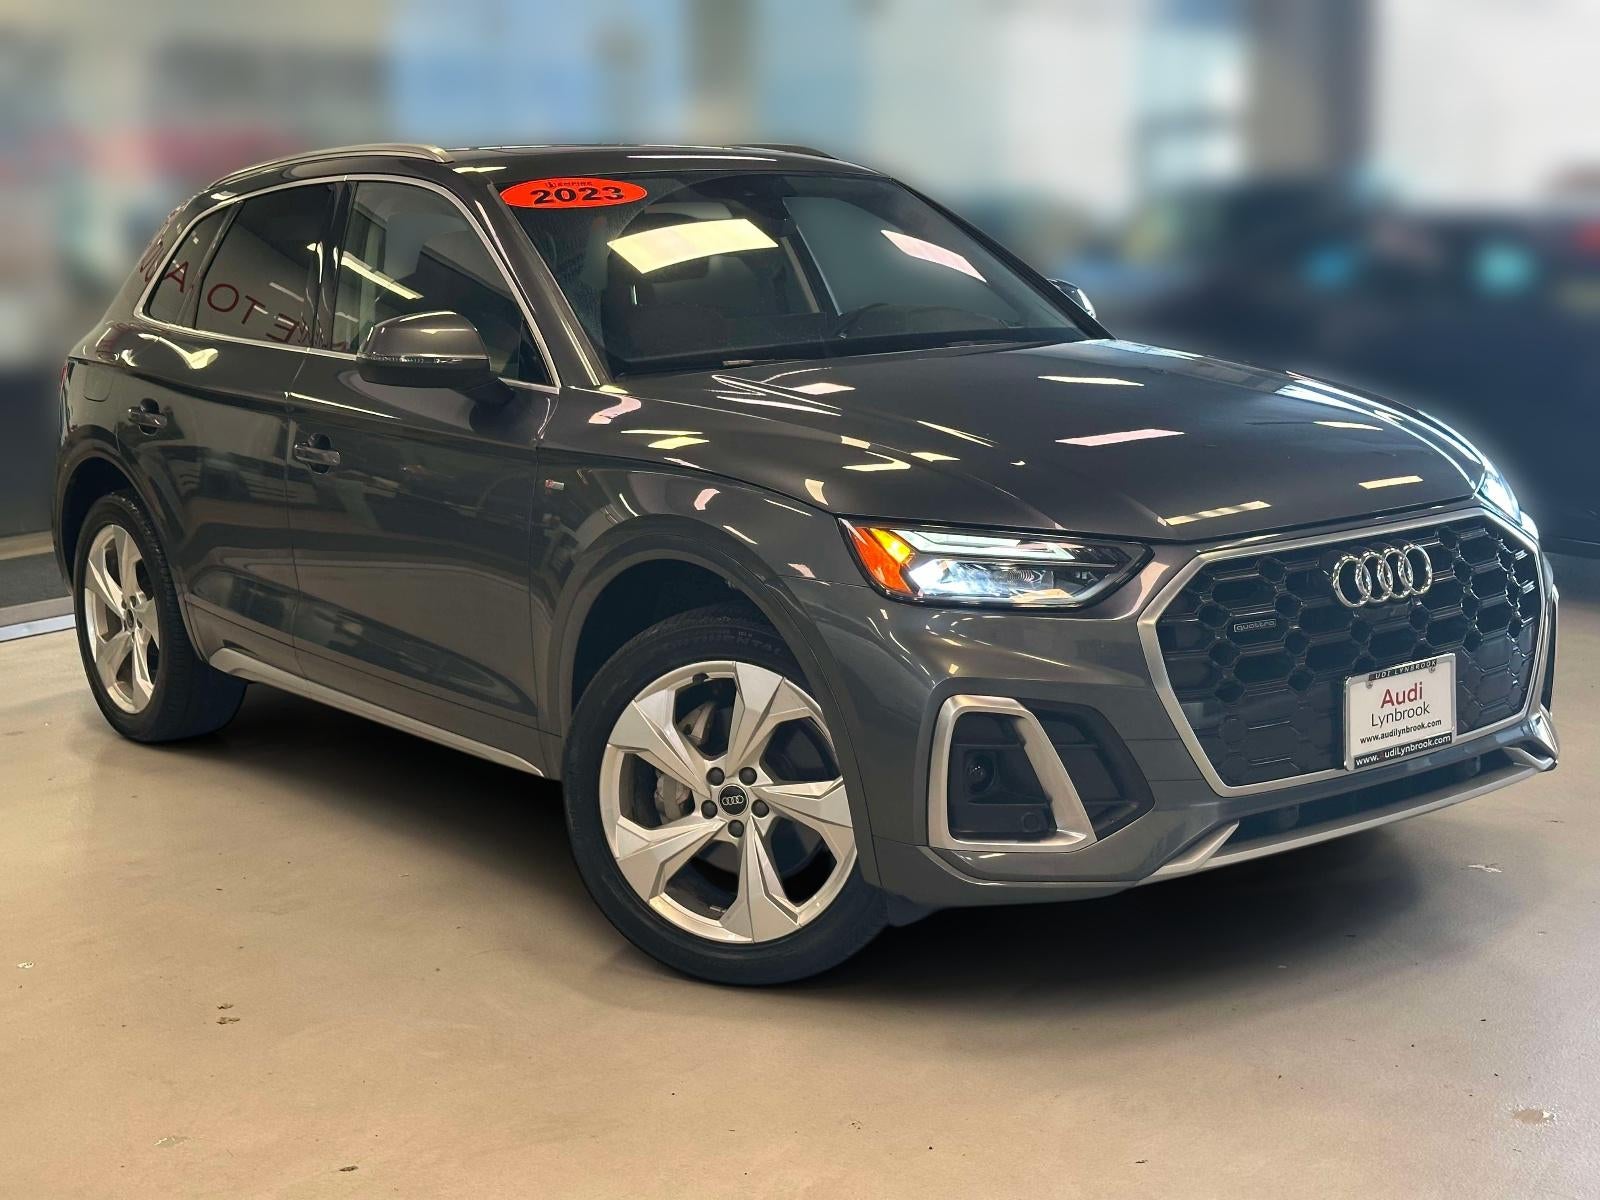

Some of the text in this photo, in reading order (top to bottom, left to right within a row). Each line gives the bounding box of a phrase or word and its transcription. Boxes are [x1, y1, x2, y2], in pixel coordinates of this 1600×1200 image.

[530, 187, 624, 204] 2023
[1236, 620, 1275, 631] quattro
[1394, 660, 1437, 675] LYNBROOK
[1380, 682, 1423, 708] Audi
[1371, 701, 1431, 728] Lynbrook
[1360, 719, 1442, 744] www.audilynbrook.com
[1355, 734, 1451, 766] www.udiLynbrook.com
